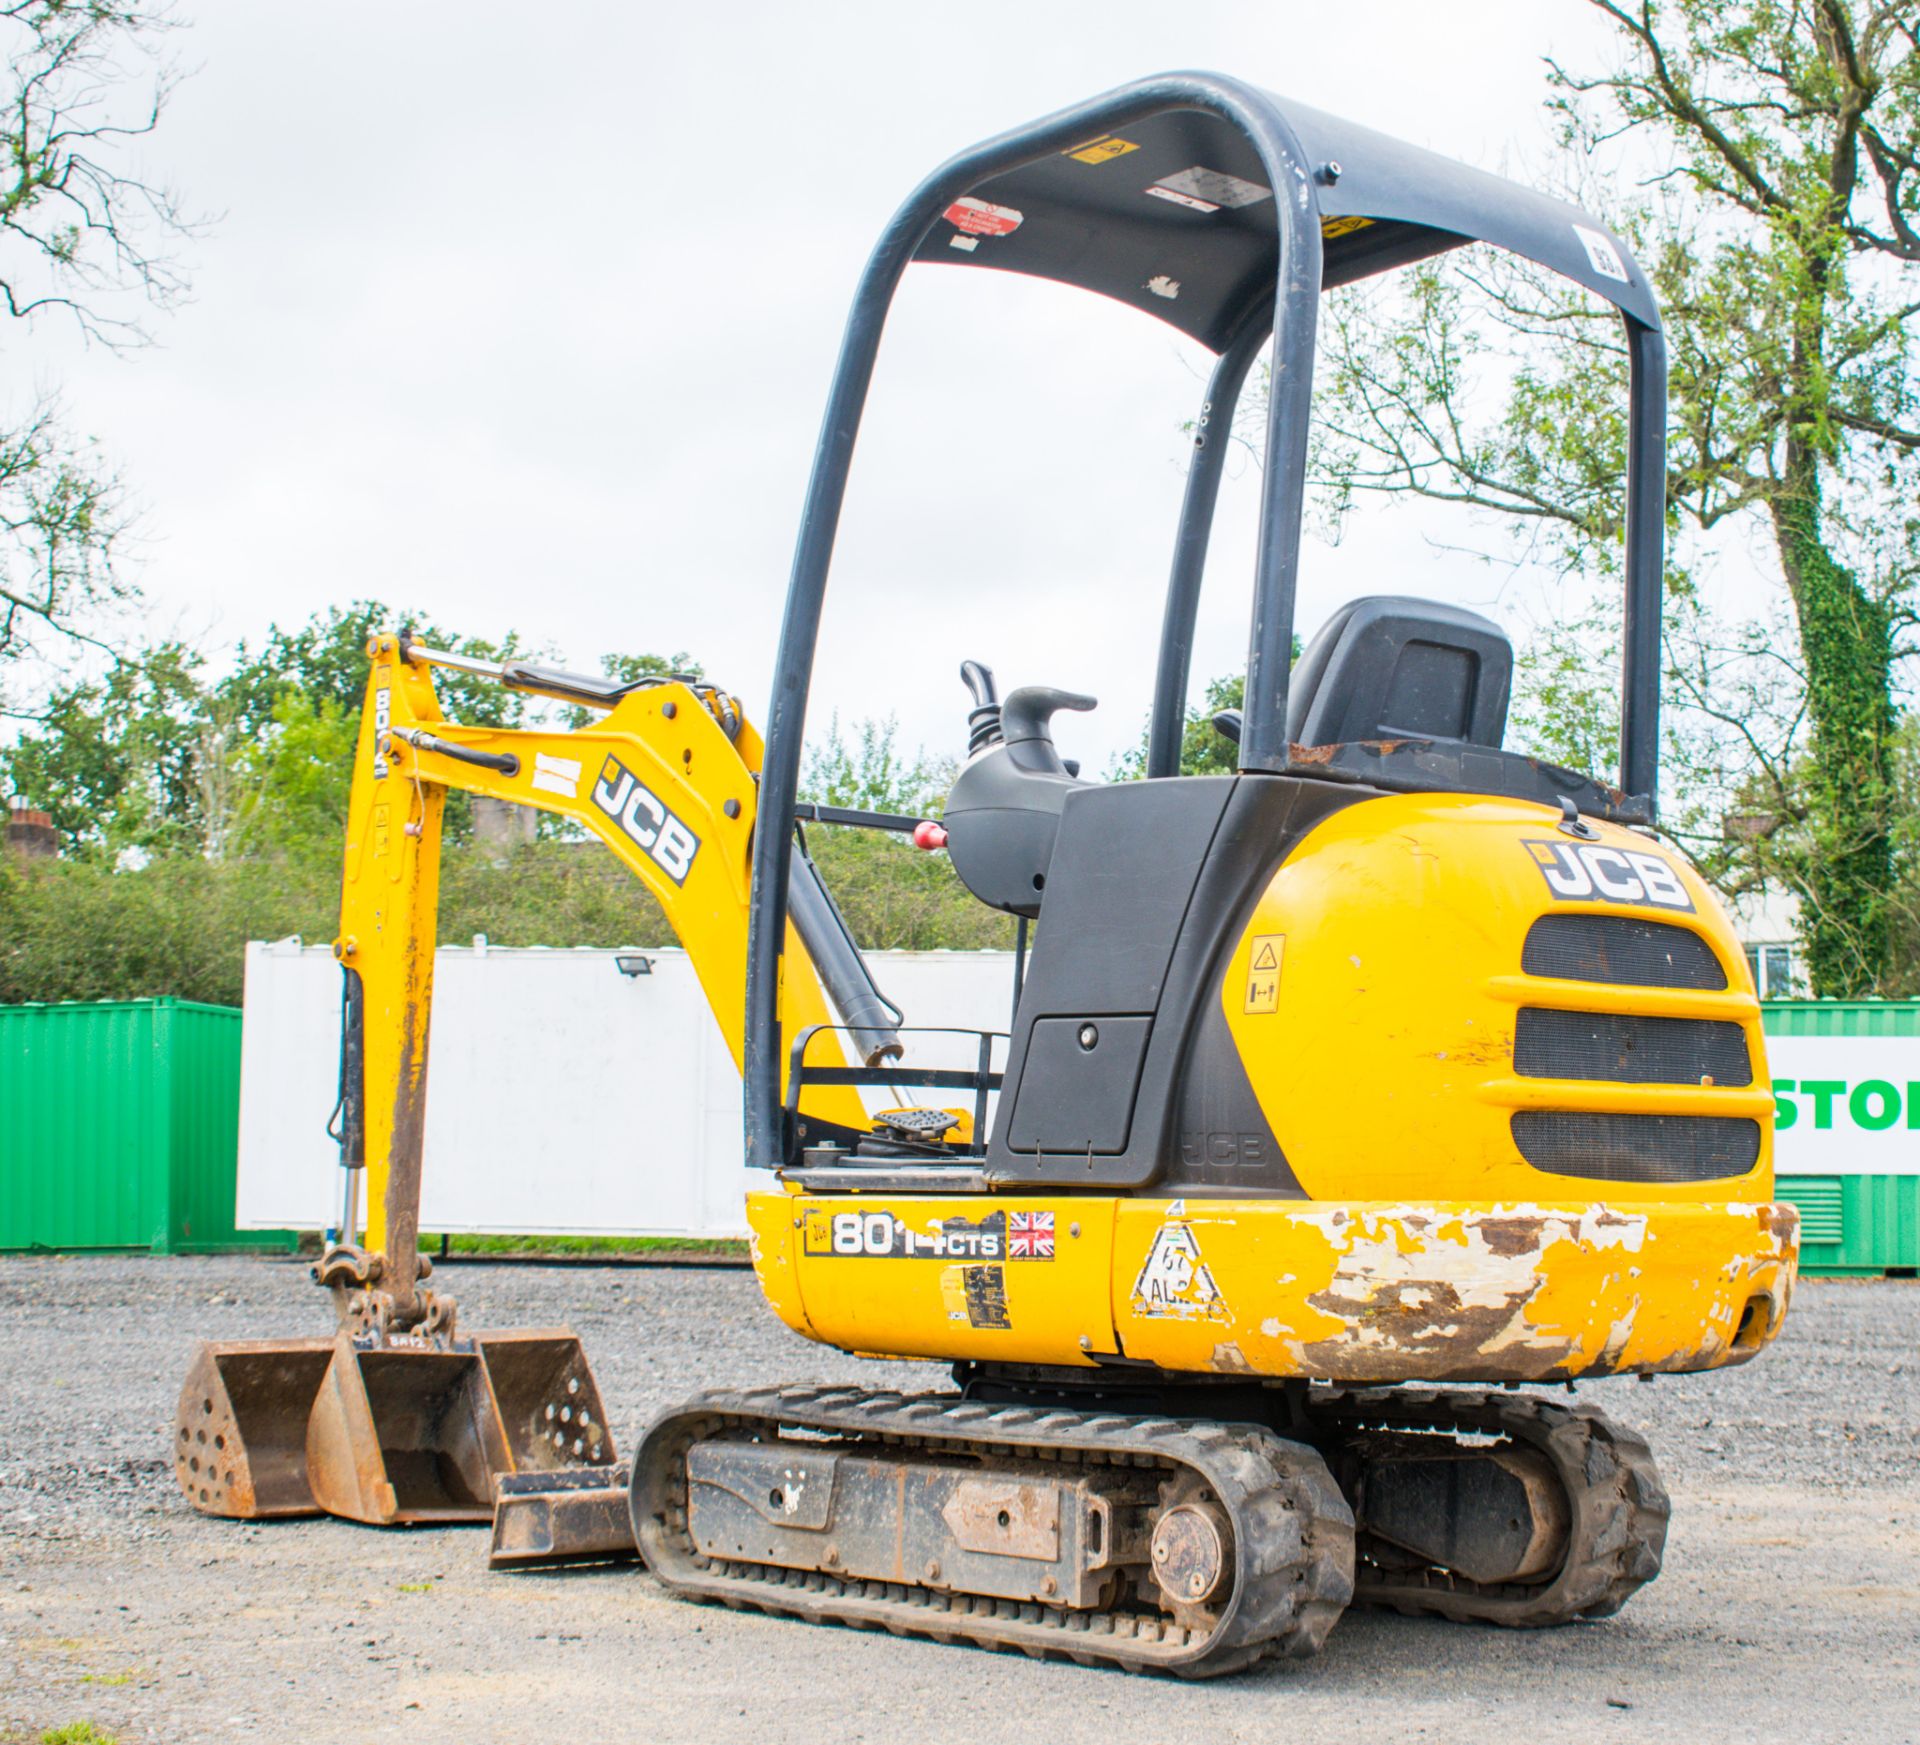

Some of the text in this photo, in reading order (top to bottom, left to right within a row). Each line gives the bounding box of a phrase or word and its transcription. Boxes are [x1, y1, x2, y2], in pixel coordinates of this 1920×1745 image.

[594, 772, 697, 880] JCB
[1544, 844, 1691, 907] JCB
[1771, 1079, 1920, 1131] STO
[1182, 1131, 1268, 1167] JCB
